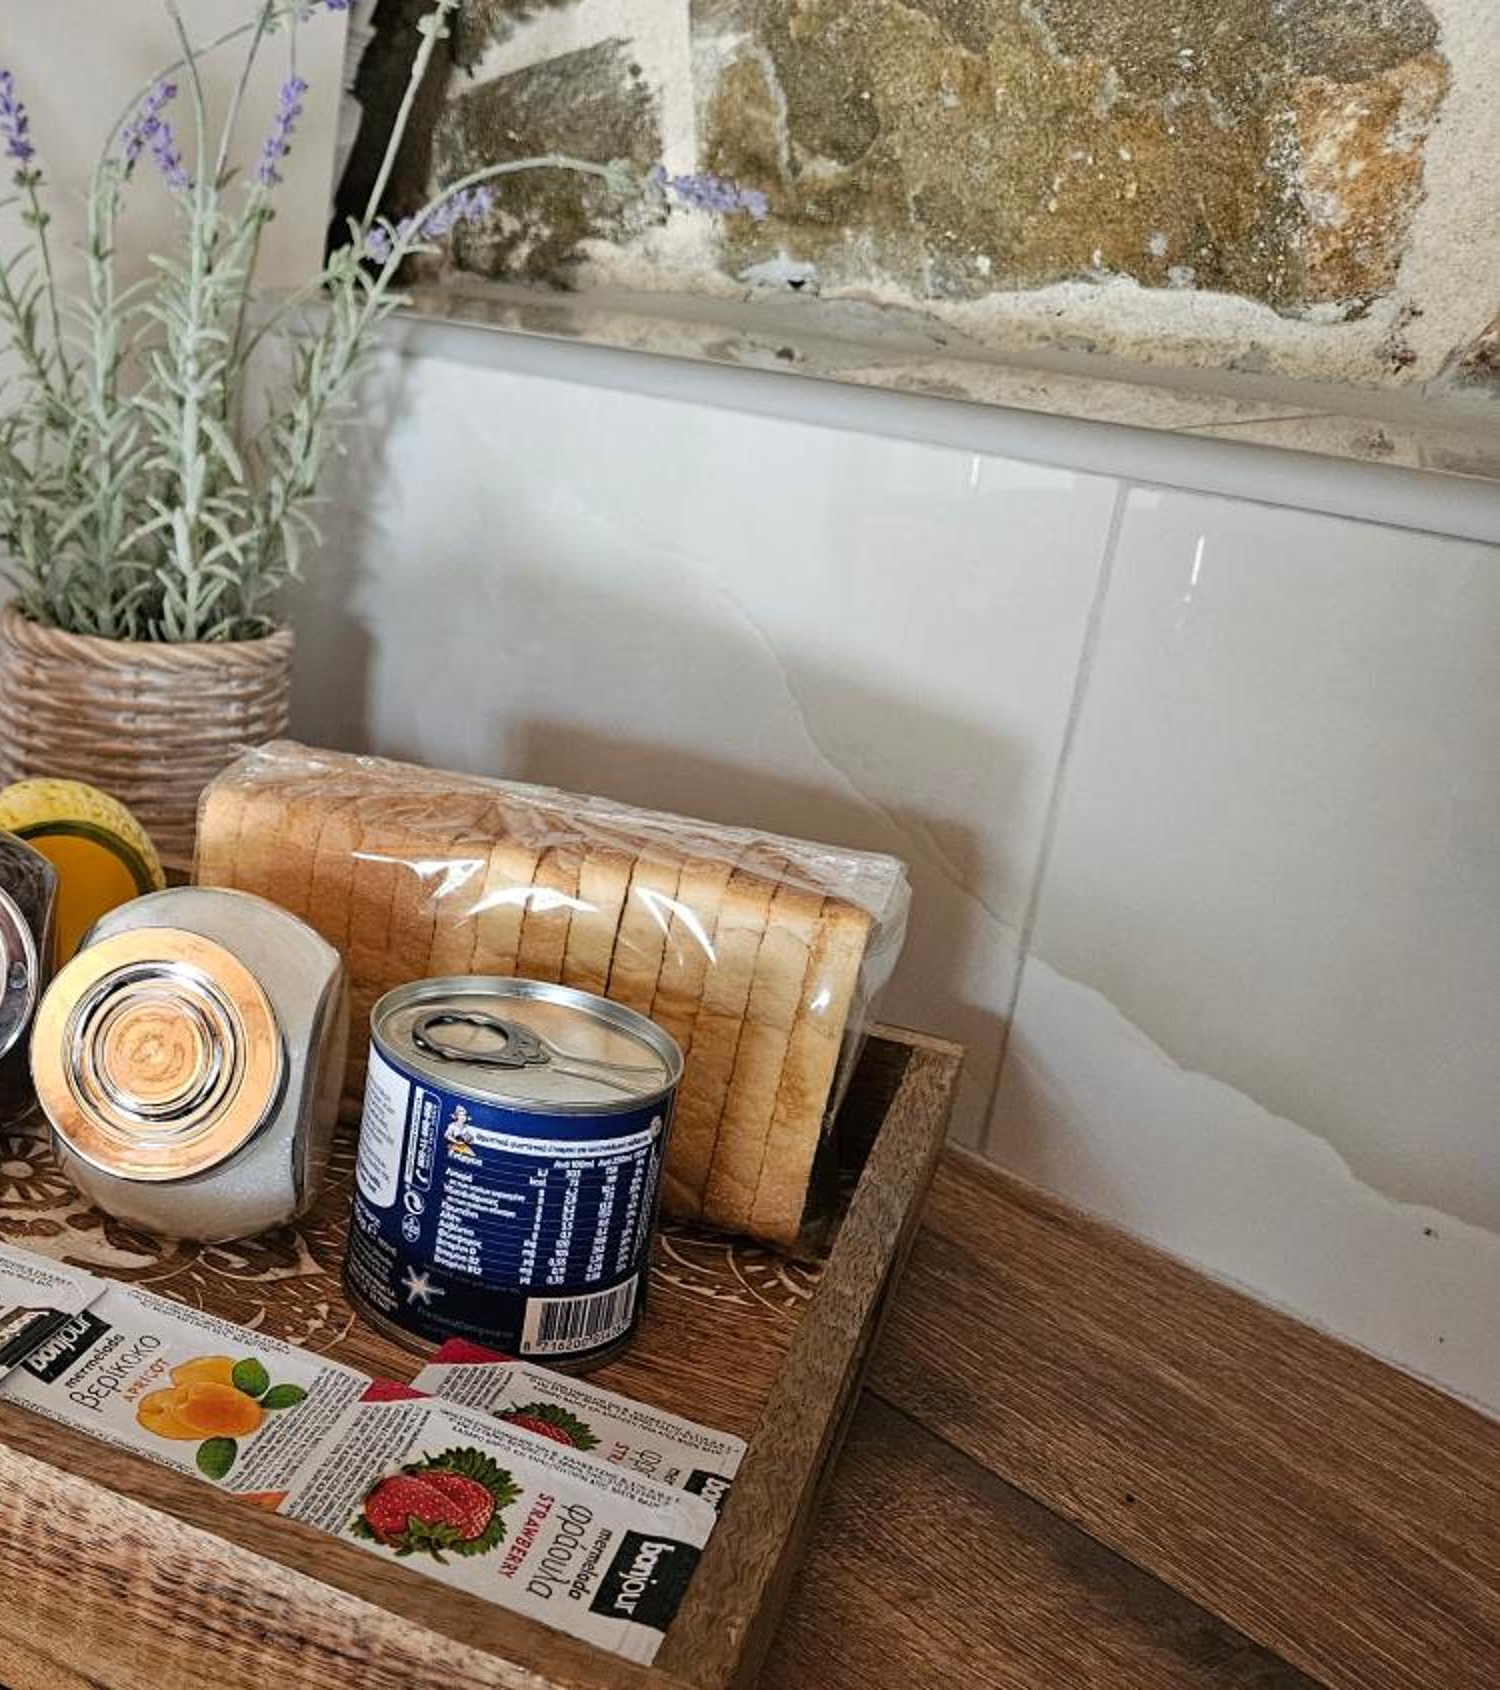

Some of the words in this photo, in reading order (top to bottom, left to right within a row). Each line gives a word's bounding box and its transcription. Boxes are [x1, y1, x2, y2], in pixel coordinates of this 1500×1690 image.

[64, 1332, 127, 1389] mermelada
[68, 1332, 163, 1413] βερίκοκο
[123, 1356, 171, 1404] APRICOT
[497, 1492, 557, 1580] STRAWBERRY
[524, 1502, 594, 1600] φράουλα
[568, 1527, 614, 1602] mermelada
[613, 1540, 677, 1618] bonjour
